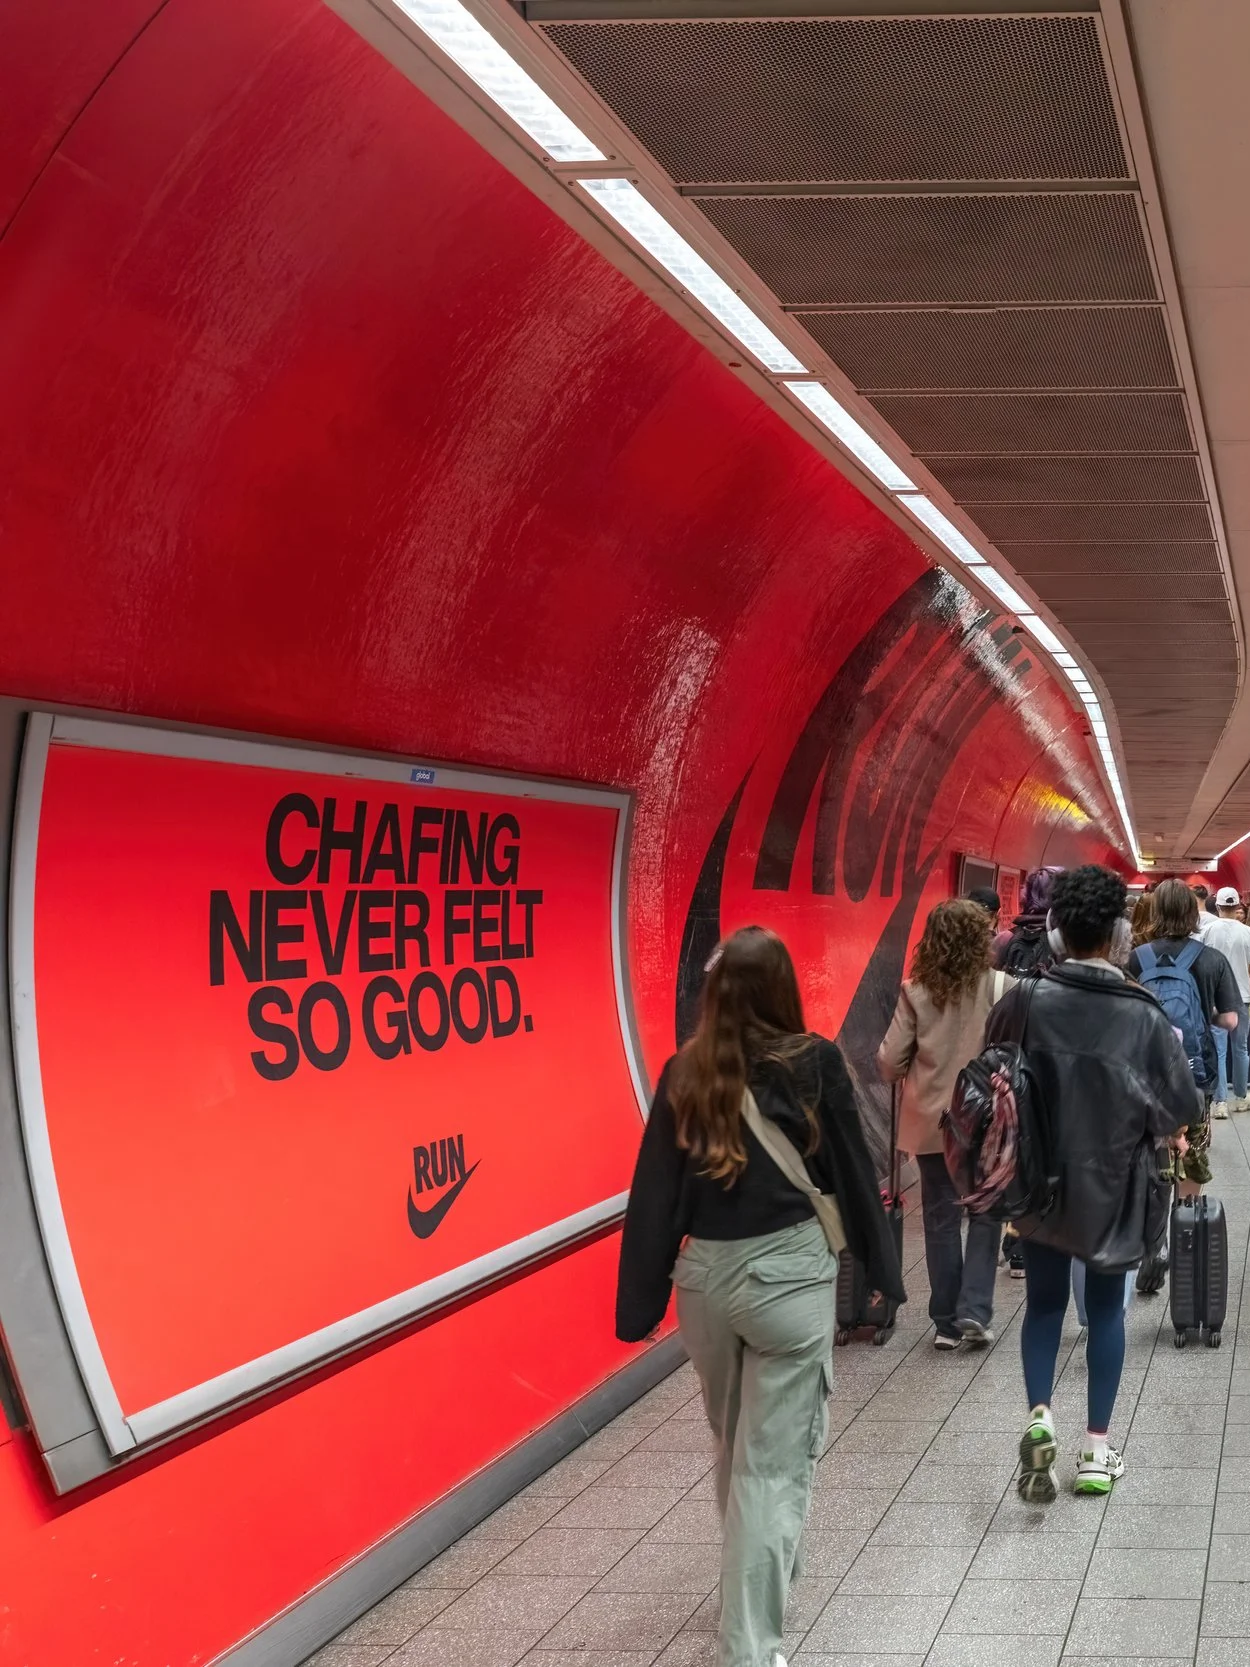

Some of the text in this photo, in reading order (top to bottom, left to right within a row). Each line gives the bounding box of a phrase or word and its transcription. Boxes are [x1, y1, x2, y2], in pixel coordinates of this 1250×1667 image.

[265, 793, 521, 886] CHAFING
[209, 889, 544, 987] NEVER FELT
[247, 965, 534, 1081] SO GOOD.
[413, 1134, 468, 1194] RUN
